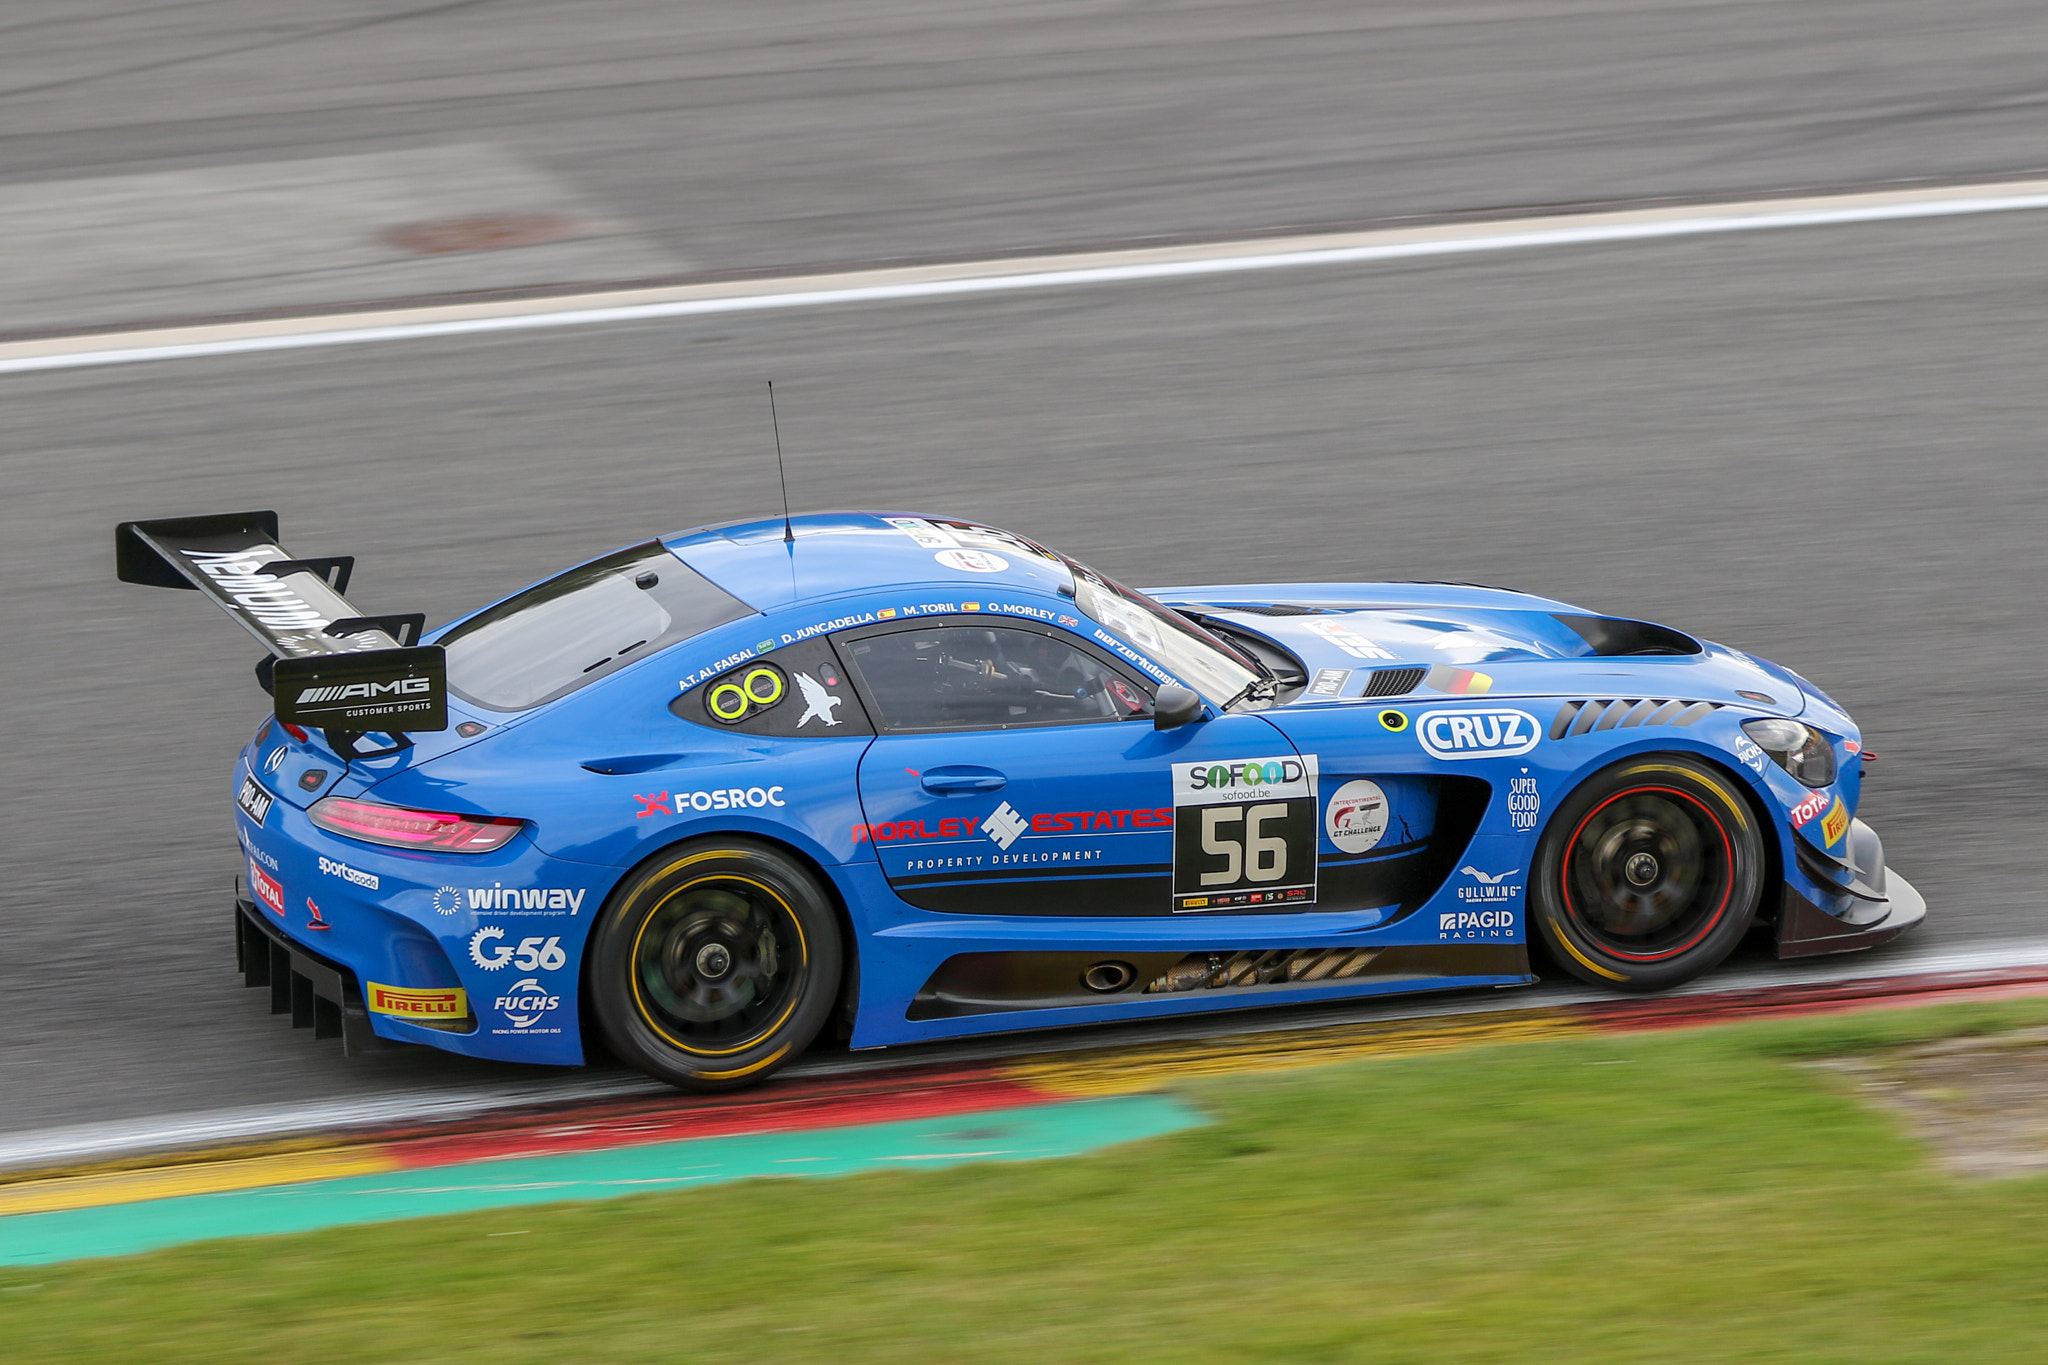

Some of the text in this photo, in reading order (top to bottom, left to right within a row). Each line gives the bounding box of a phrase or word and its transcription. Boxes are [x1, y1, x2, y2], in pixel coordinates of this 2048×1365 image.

[903, 602, 958, 616] M. TORIL
[988, 602, 1056, 621] O. MORLEY
[794, 612, 875, 640] JUNCADELLA
[1093, 628, 1183, 687] berzerkdesi
[678, 648, 756, 691] A.T. AL FAISAL
[341, 677, 430, 700] AMG
[346, 702, 432, 718] CUSTOMER SPORTS
[1427, 714, 1528, 749] CRUZ
[1738, 743, 1763, 764] FUCHS
[1190, 760, 1303, 790] SOFOOD
[1510, 778, 1538, 794] SUPER
[239, 780, 270, 821] PRO-AM
[674, 786, 786, 814] FOSROC
[1222, 788, 1271, 801] sofood.be
[1333, 795, 1381, 806] INTERCONTINENTAL
[852, 808, 1173, 843] MORLEY ESTATES
[1511, 812, 1538, 828] FOOD
[1333, 825, 1381, 838] GT CHALLENGE
[1200, 803, 1288, 886] 56
[907, 849, 1103, 871] PROPERTY DEVELOPMENT
[255, 869, 283, 910] TOTAL
[467, 882, 587, 916] winway
[1458, 885, 1517, 899] GULLWING
[1457, 910, 1514, 929] PAGID
[1439, 929, 1514, 940] RACING
[468, 925, 567, 972] G56
[376, 989, 458, 1013] PIRELLI
[494, 995, 561, 1011] FUCHS
